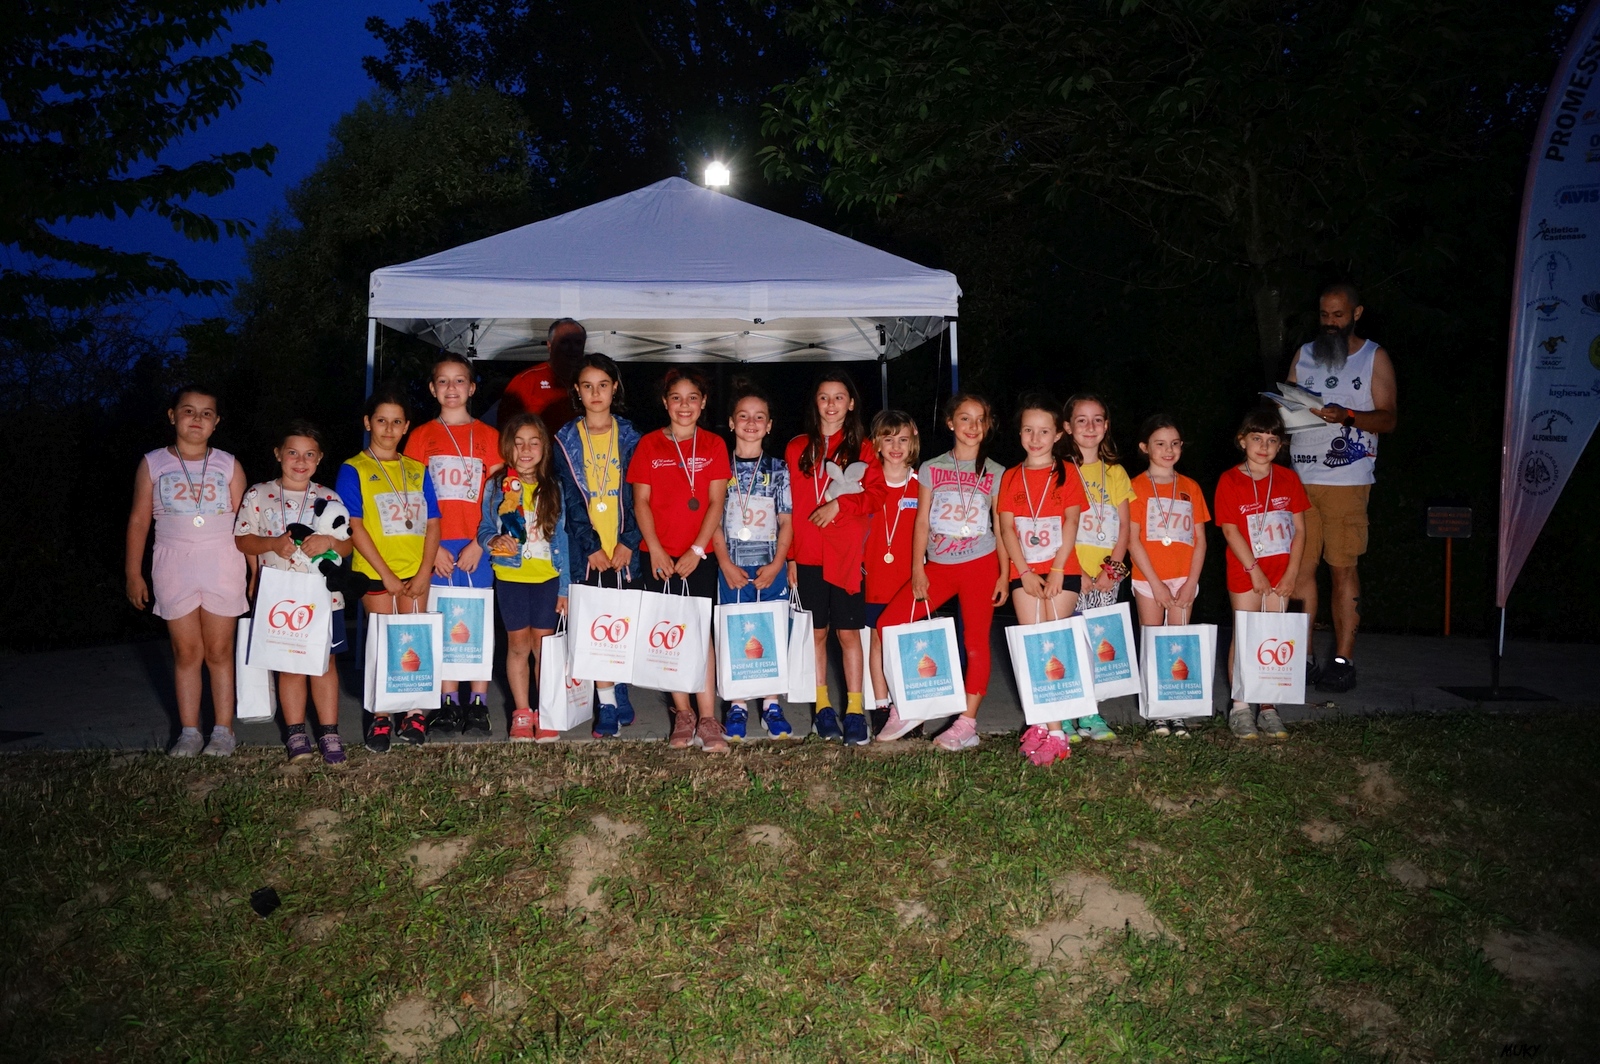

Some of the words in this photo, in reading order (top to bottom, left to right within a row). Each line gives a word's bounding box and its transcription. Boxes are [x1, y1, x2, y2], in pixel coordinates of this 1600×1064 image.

[1545, 27, 1600, 162] PROMESS
[1560, 190, 1600, 204] AVIS
[1544, 233, 1587, 241] Castenaso
[1546, 226, 1579, 234] Atletica
[438, 468, 474, 487] 102
[174, 482, 217, 502] 253
[742, 508, 767, 527] 92
[940, 503, 980, 524] 252
[1157, 511, 1191, 532] 270
[1020, 530, 1051, 548] 08
[1264, 522, 1292, 541] 111
[268, 599, 314, 631] 60
[267, 628, 309, 638] 1959-2019
[590, 614, 629, 643] 60
[649, 620, 684, 650] 60
[590, 641, 627, 649] 1959-2019
[648, 648, 680, 657] 1959-2019
[1257, 638, 1294, 666] 60
[1033, 684, 1056, 692] INSIEME
